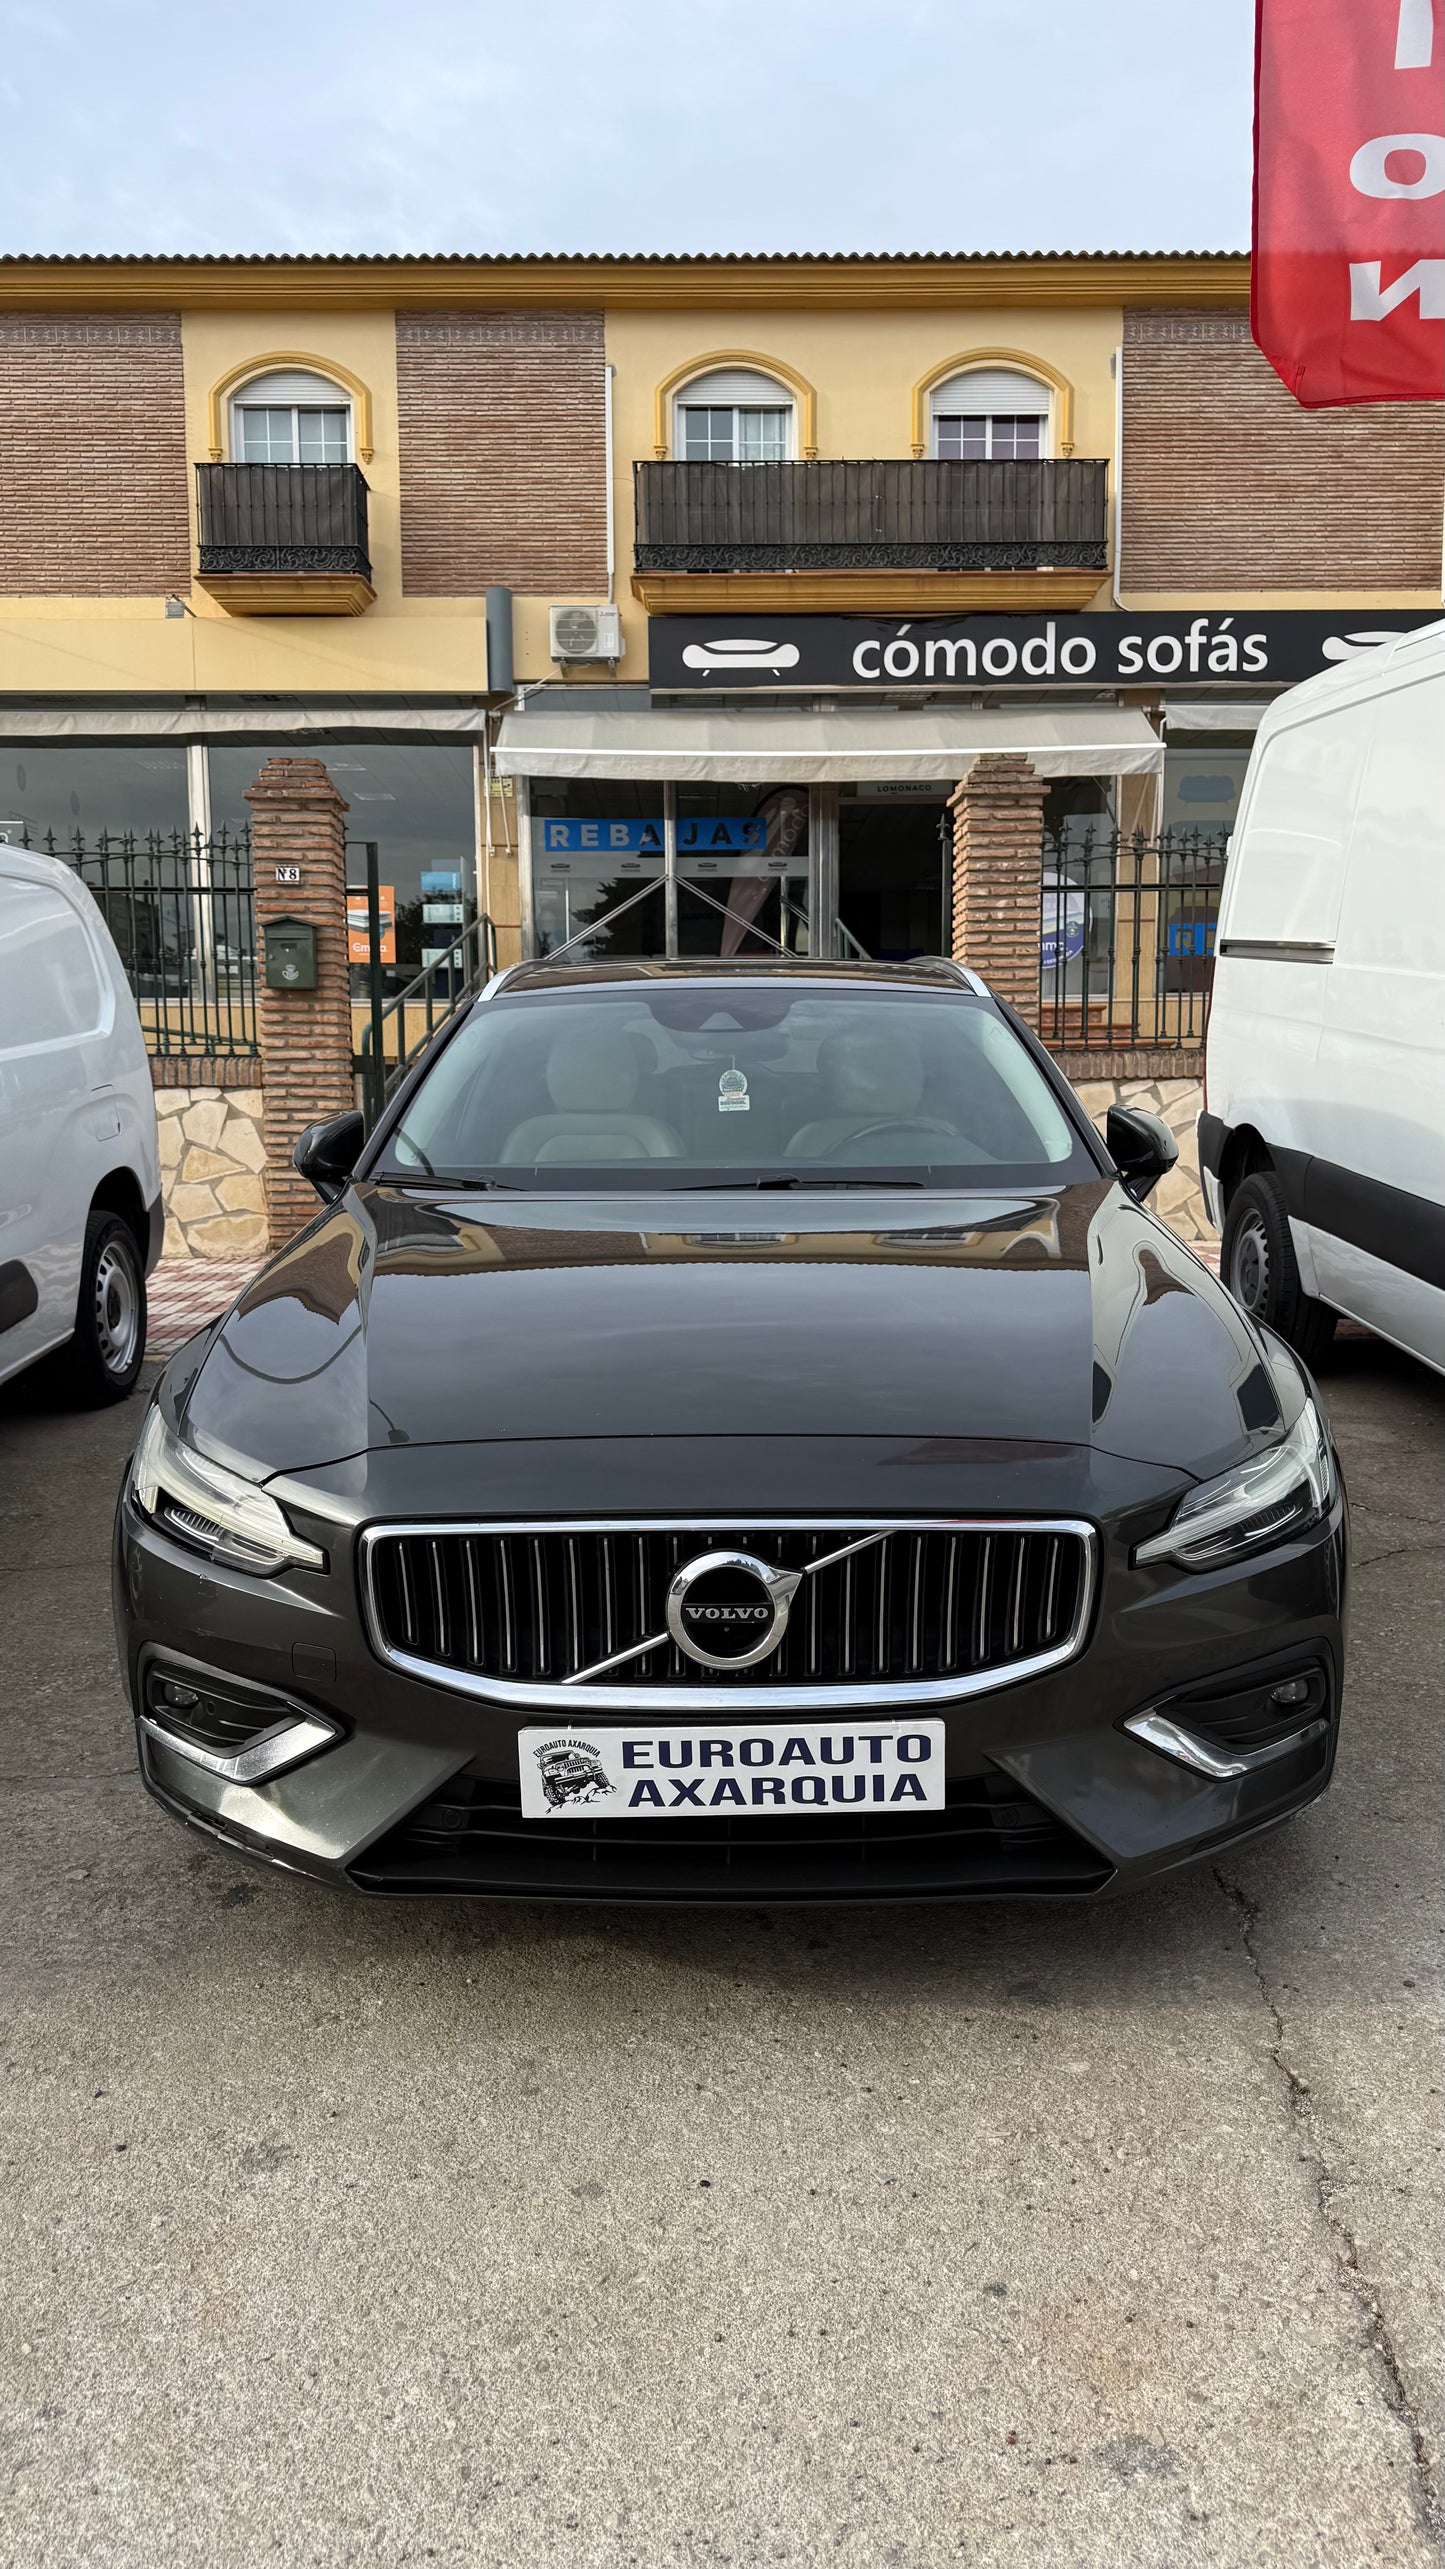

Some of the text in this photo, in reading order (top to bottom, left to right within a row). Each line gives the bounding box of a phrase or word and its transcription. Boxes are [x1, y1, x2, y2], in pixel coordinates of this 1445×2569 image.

[852, 617, 1269, 679] cómodo sofás
[877, 784, 932, 794] LOMONACO
[549, 821, 762, 848] REBAJAS
[289, 868, 297, 880] 8
[686, 1607, 769, 1619] VOLVO
[532, 1739, 601, 1758] EUROAUTO AXARQUIA
[621, 1734, 932, 1769] EUROAUTO
[628, 1773, 929, 1807] AXARQUIA
